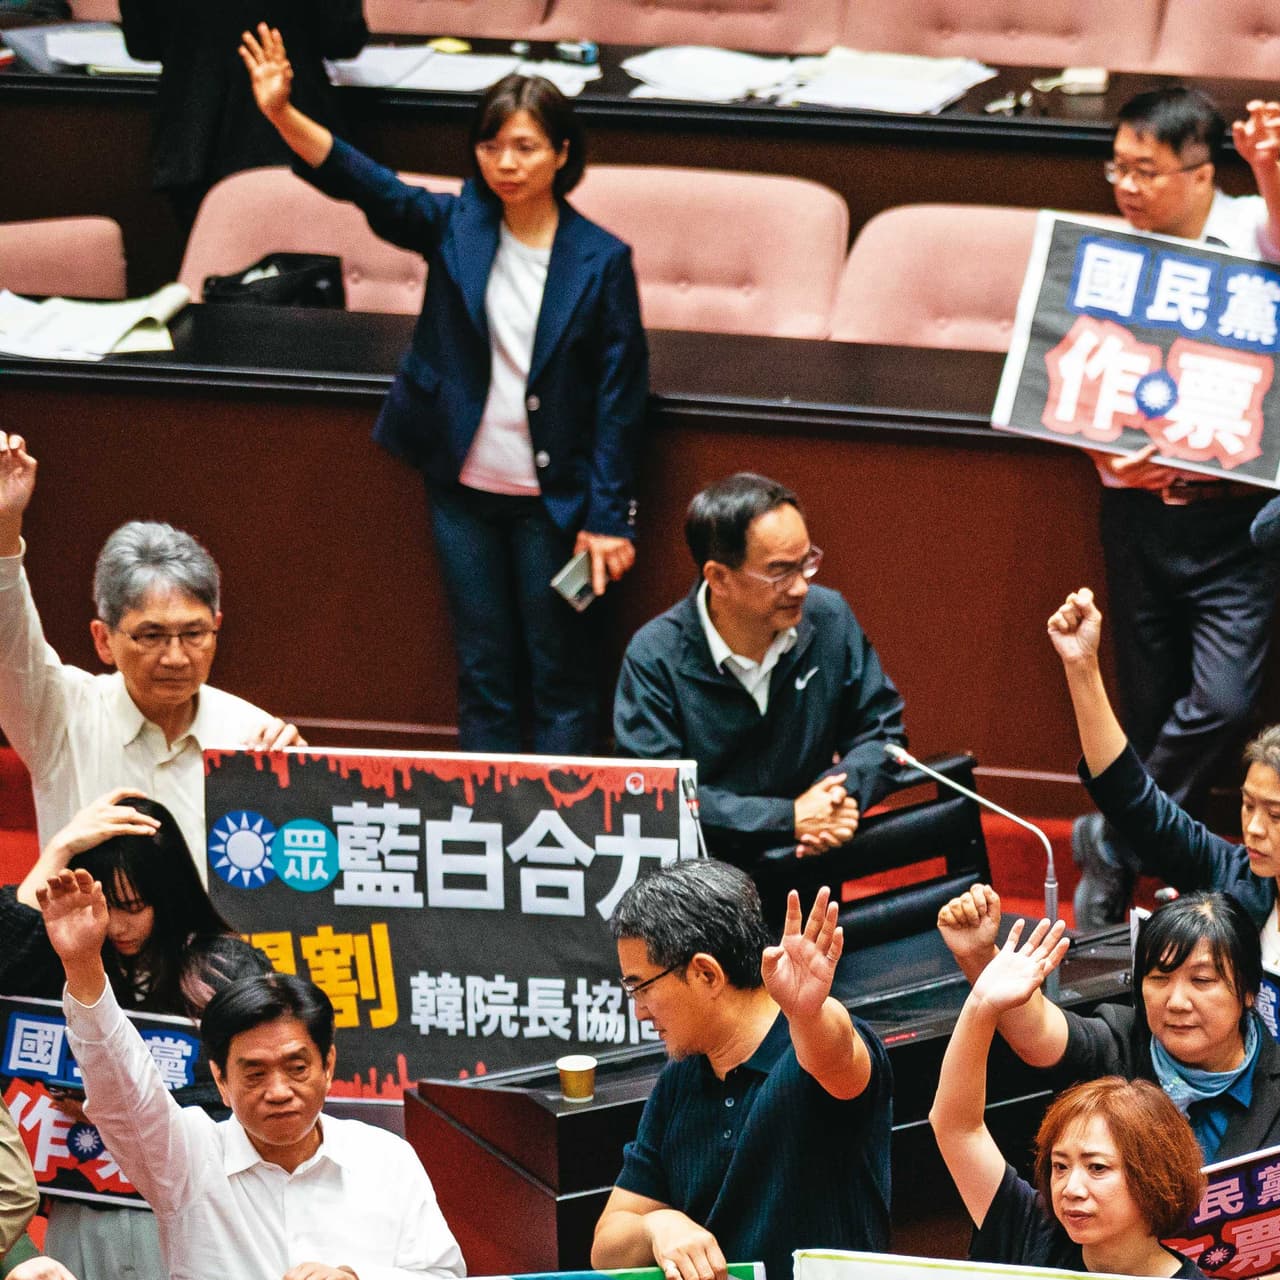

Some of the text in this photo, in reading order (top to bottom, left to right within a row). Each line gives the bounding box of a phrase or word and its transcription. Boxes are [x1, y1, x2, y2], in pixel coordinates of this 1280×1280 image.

[1055, 329, 1262, 455] 作票
[8, 1018, 193, 1090] 國黨
[7, 1090, 136, 1183] 作
